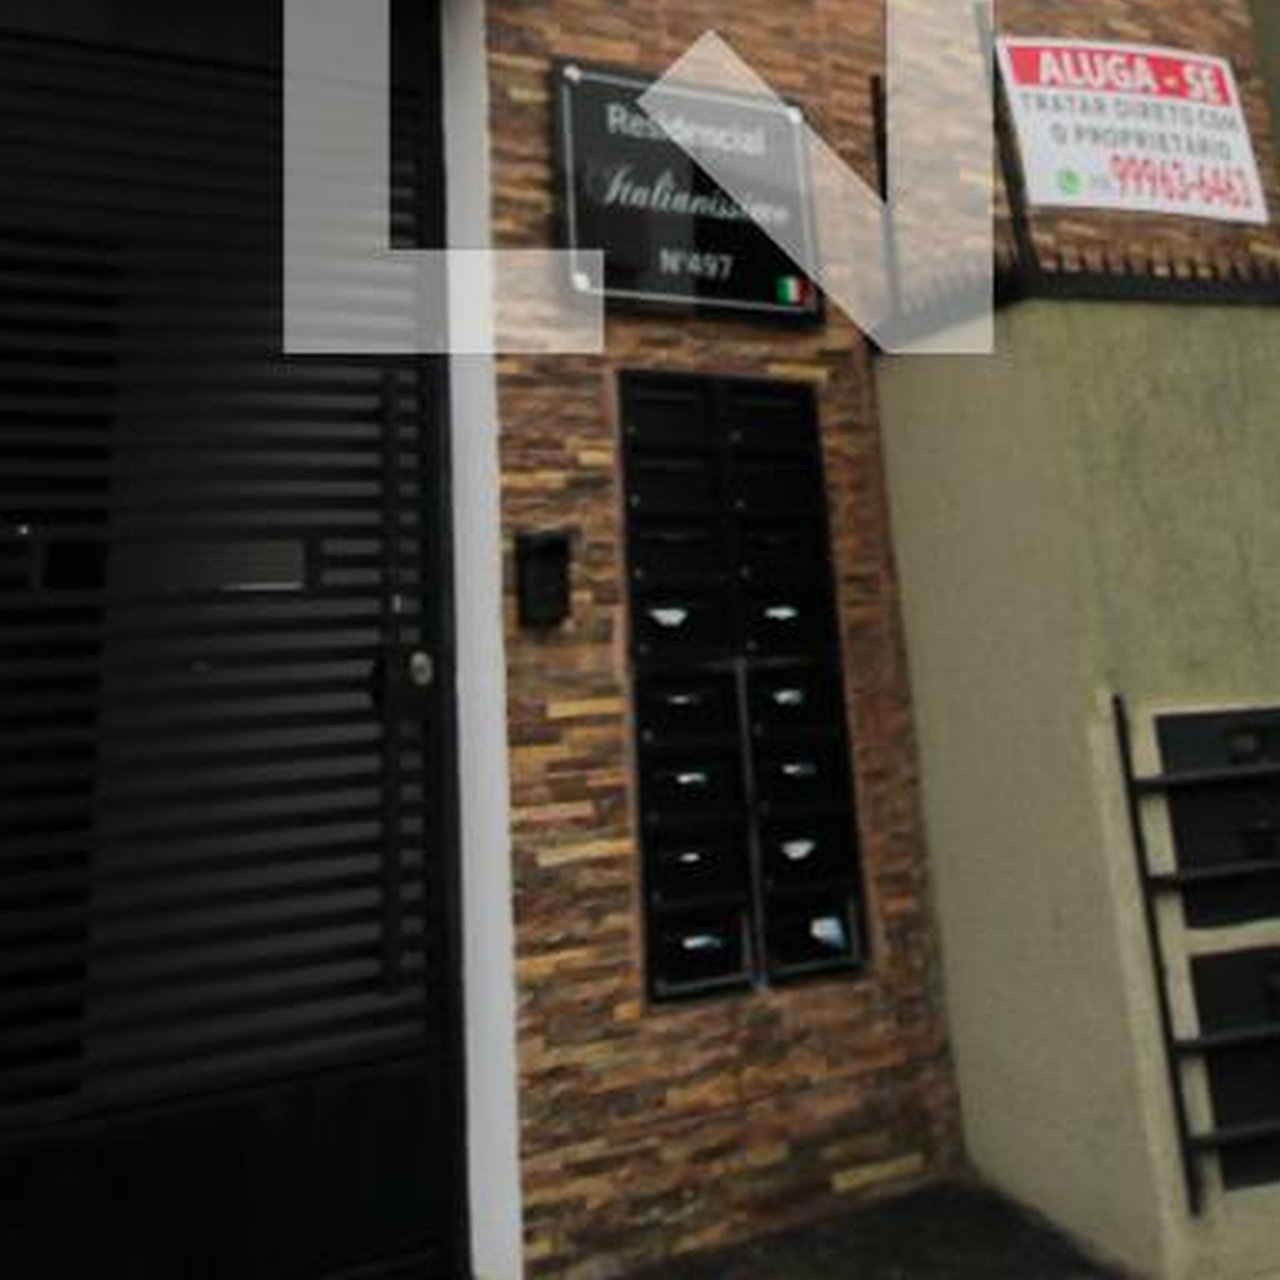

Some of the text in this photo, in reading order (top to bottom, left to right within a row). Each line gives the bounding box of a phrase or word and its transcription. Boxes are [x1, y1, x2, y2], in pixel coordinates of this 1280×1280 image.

[1038, 49, 1158, 94] ALUGA
[1182, 62, 1224, 104] SE
[606, 103, 766, 157] Residencial
[1020, 92, 1107, 116] TRATAR
